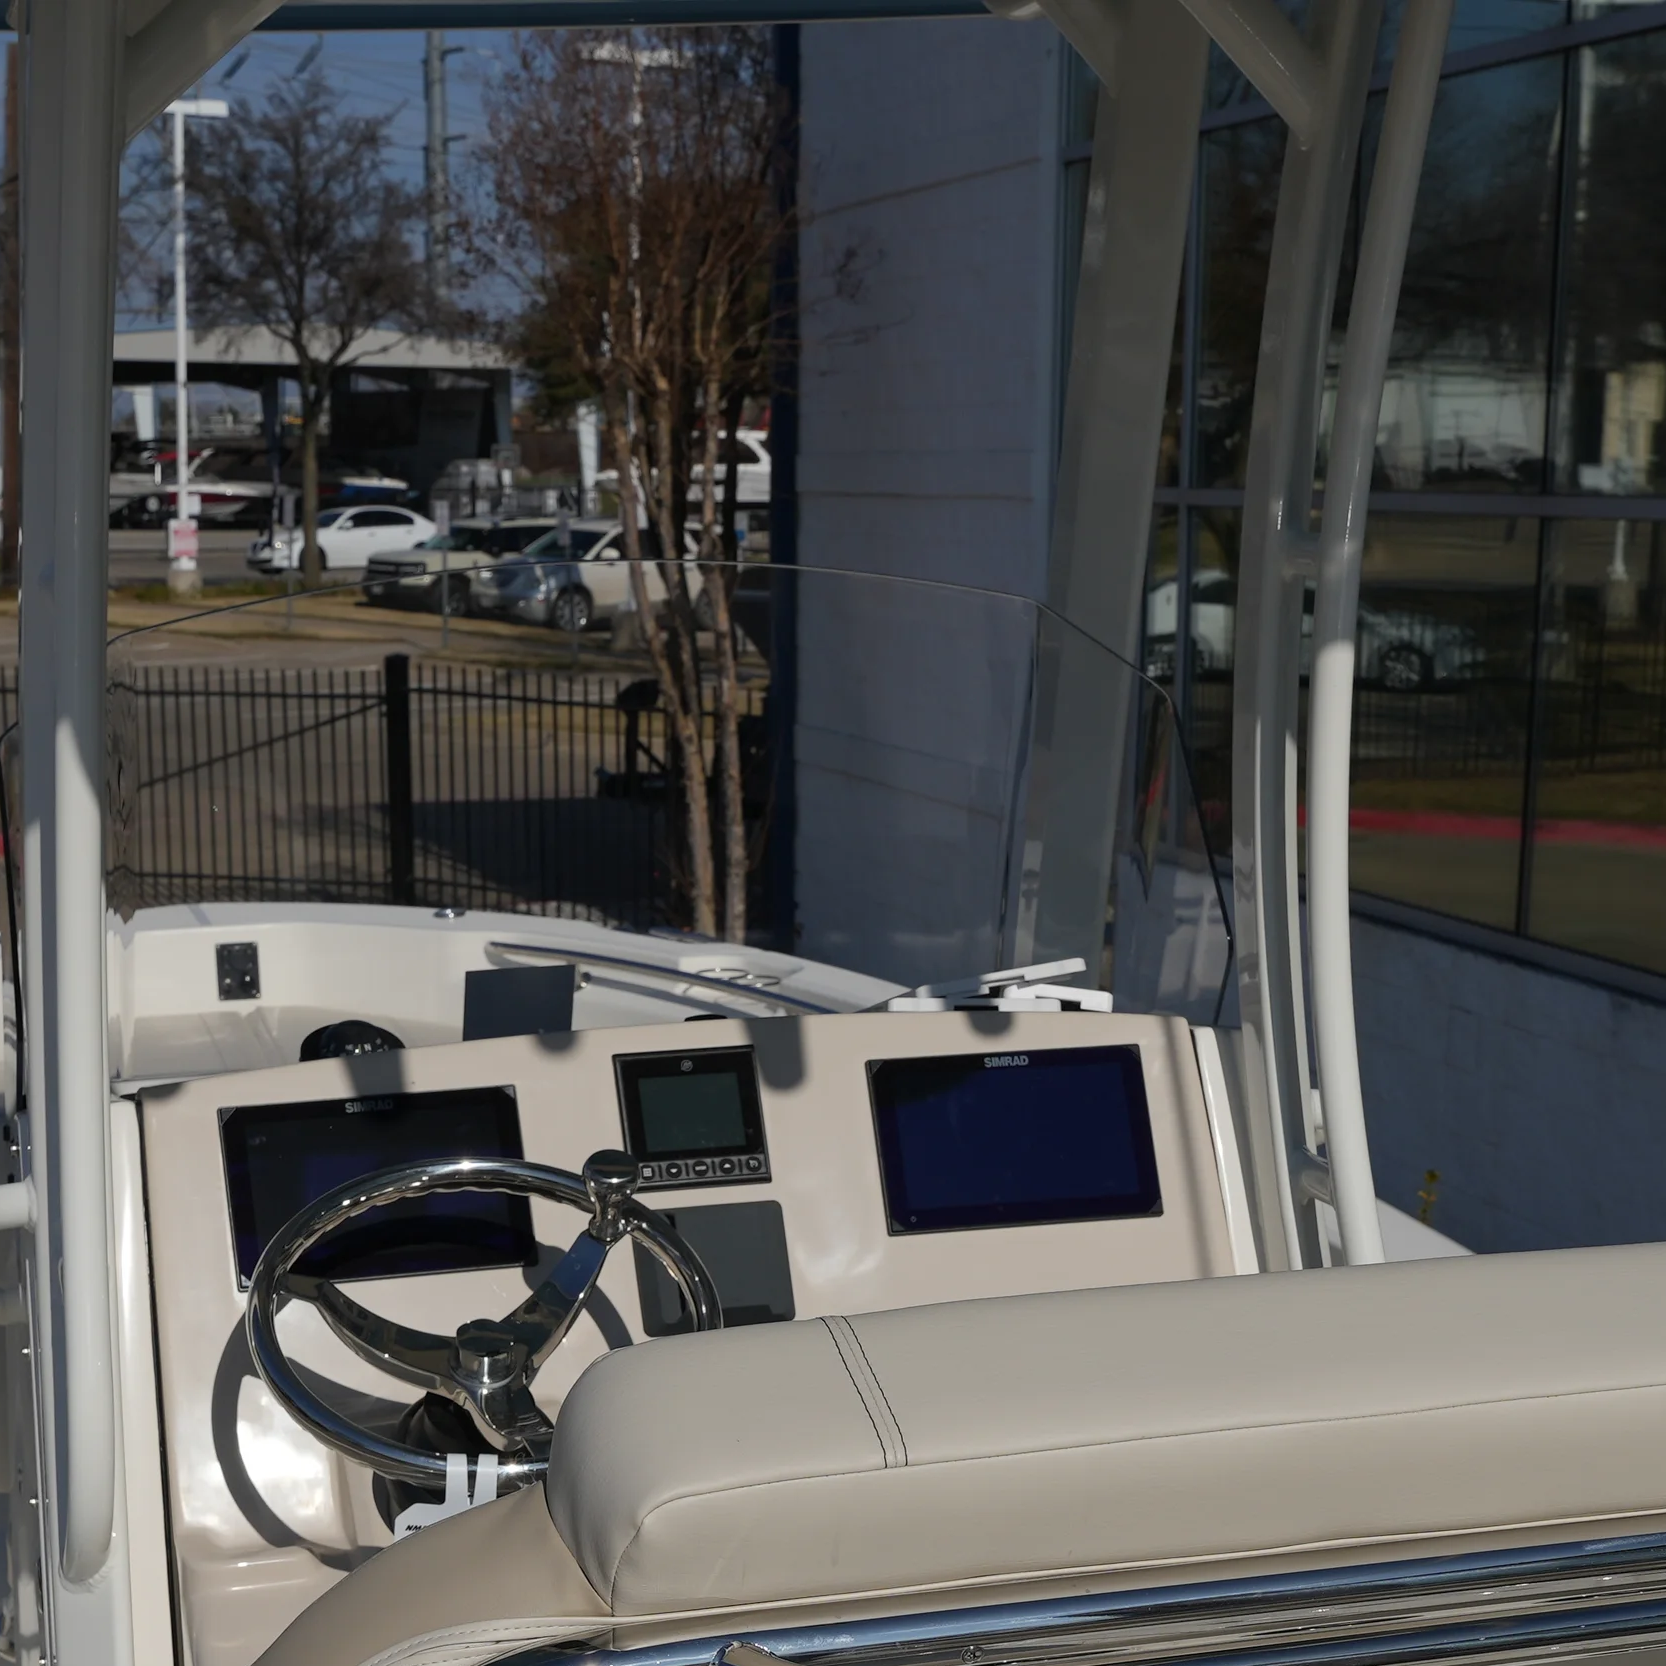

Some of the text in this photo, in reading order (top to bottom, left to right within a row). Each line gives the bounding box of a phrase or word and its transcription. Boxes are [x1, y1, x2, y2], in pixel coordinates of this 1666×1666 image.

[983, 1054, 1030, 1068] SIMRAD
[344, 1099, 394, 1114] SIMRAD
[405, 1523, 427, 1532] NM
